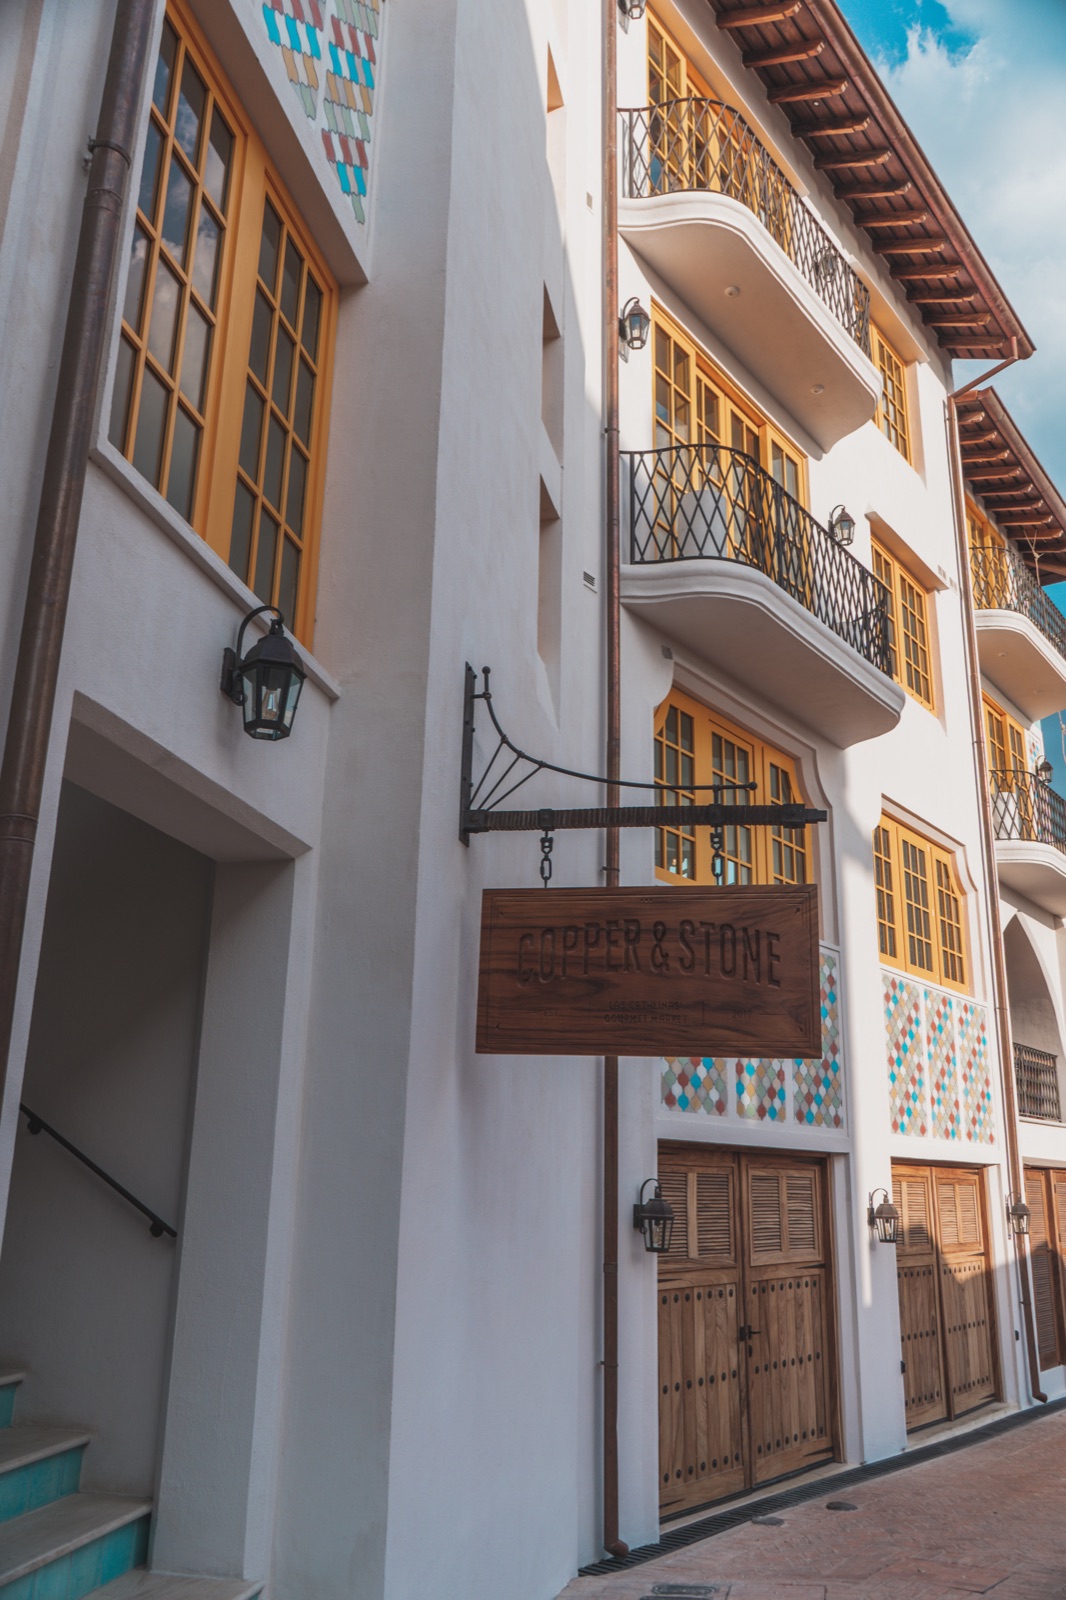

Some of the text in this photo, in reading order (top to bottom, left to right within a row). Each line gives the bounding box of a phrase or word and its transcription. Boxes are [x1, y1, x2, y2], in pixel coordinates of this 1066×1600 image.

[517, 918, 782, 989] COPPER & STONE
[608, 1000, 626, 1011] LAS
[603, 1013, 648, 1024] GOURMET
